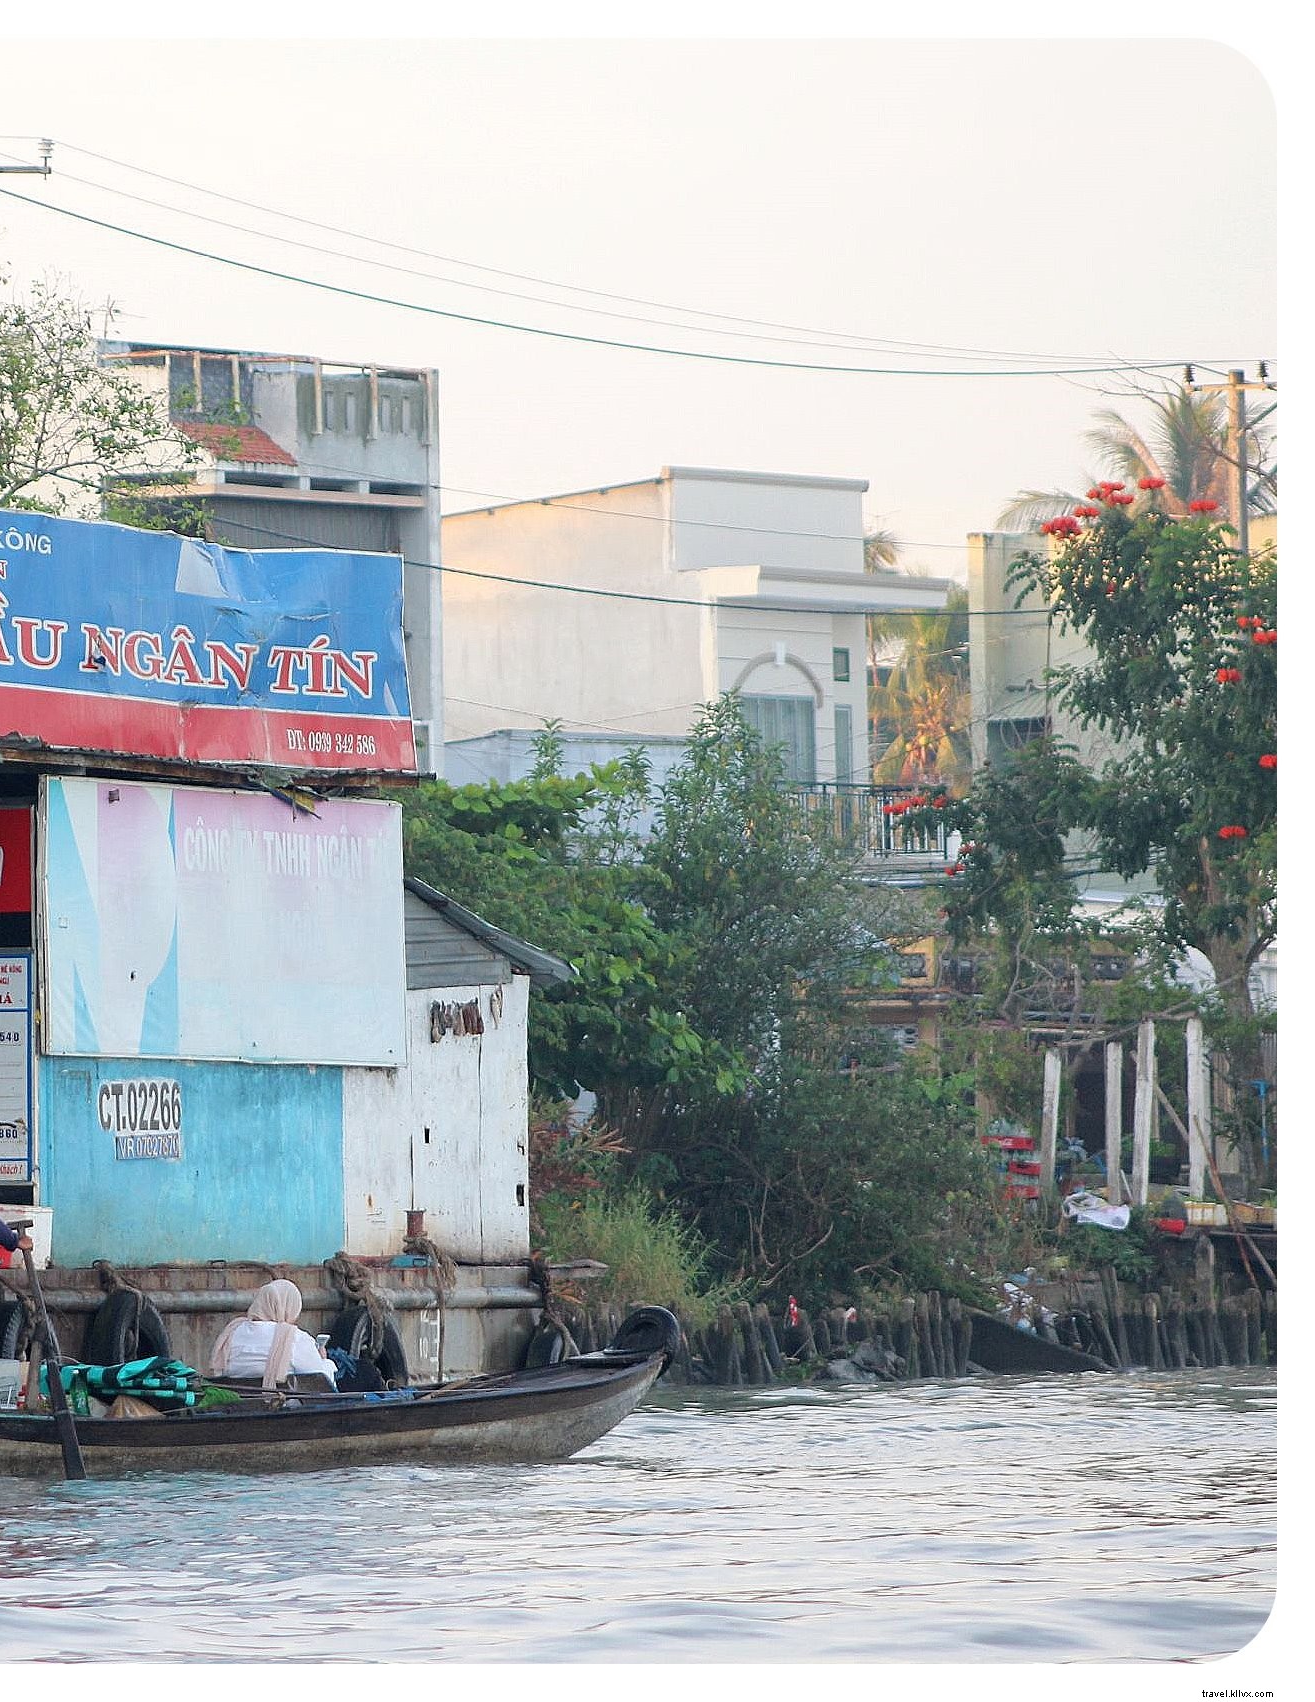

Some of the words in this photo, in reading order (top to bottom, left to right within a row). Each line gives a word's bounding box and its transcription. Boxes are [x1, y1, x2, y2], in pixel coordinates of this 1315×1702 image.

[79, 624, 261, 692] NGÂN
[267, 633, 378, 700] TÍN
[286, 728, 307, 752] ĐT:
[308, 730, 332, 753] 0939
[335, 732, 354, 754] 342
[356, 734, 376, 756] 586
[185, 816, 231, 872] CÔNG
[263, 830, 311, 877] TNHH
[316, 824, 363, 879] NGÂN
[98, 1081, 182, 1132] CT.02266
[119, 1137, 135, 1158] VR
